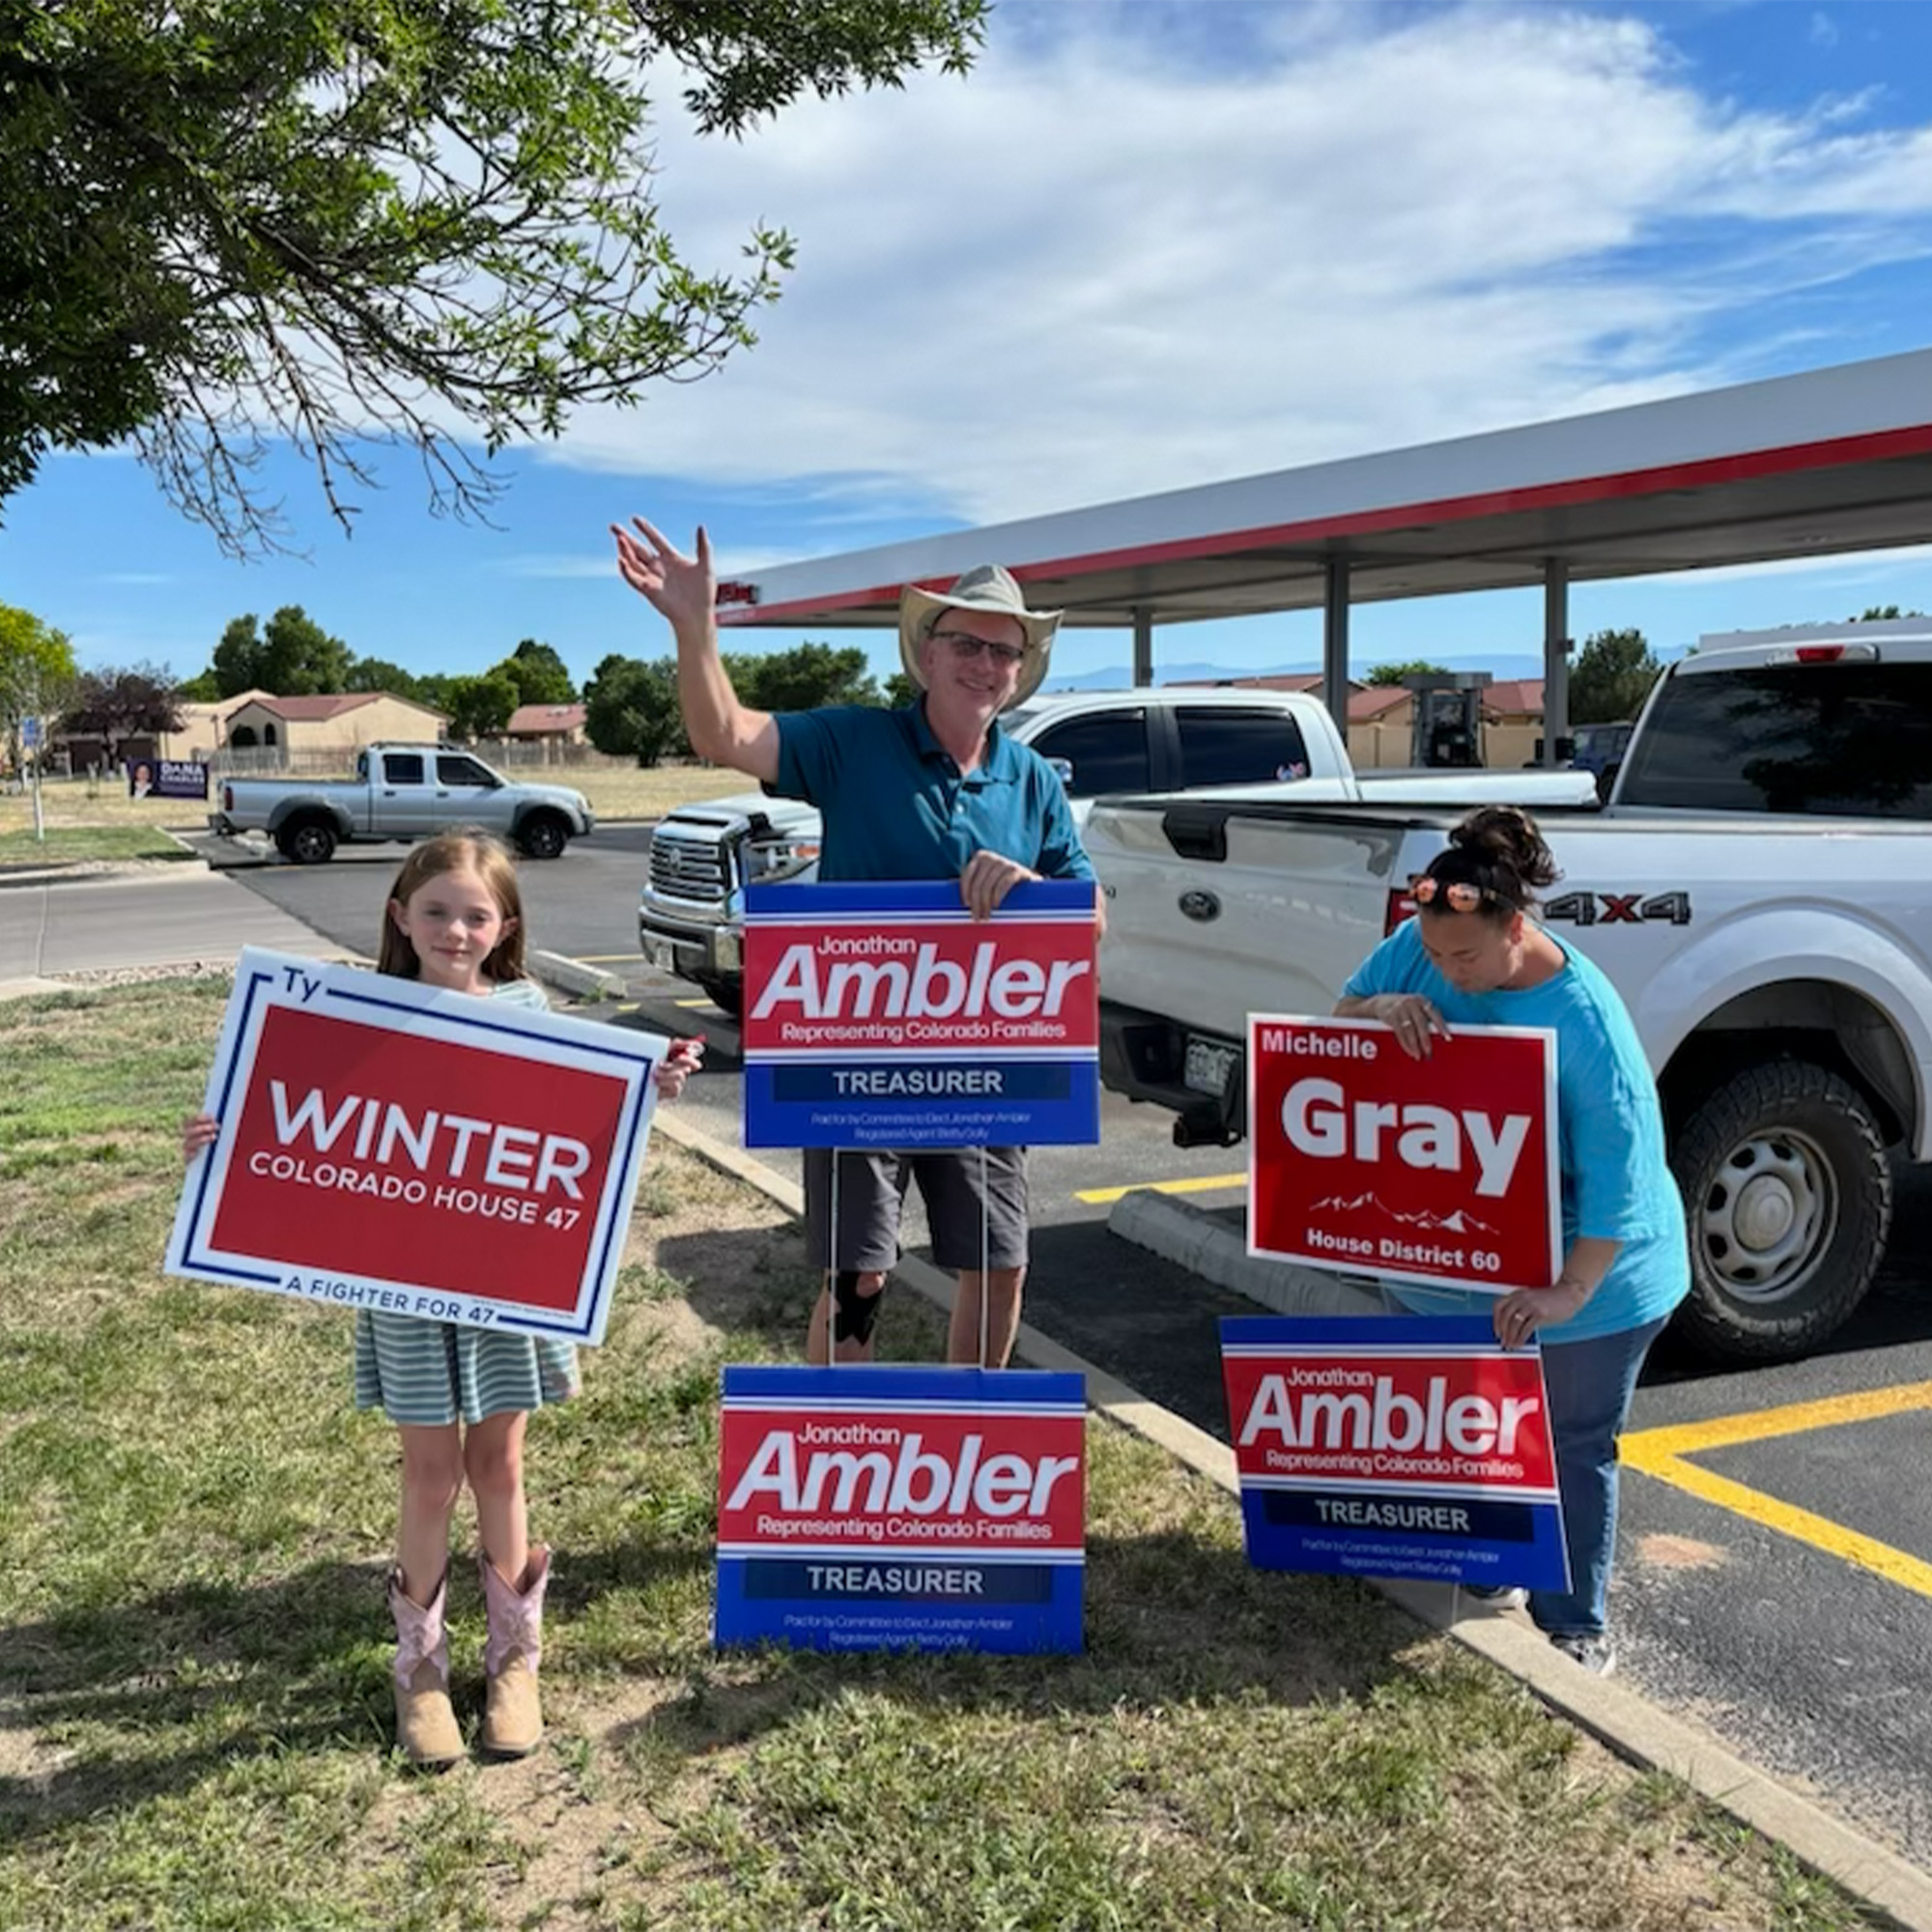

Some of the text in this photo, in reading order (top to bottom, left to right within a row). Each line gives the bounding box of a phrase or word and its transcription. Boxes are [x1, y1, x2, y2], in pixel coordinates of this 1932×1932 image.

[817, 934, 917, 955] Jonathan
[283, 965, 321, 1003] Ty
[751, 942, 1091, 1019] Ambler
[781, 1020, 1065, 1043] Representing Colorado Families
[1262, 1030, 1378, 1059] Michelle
[833, 1071, 1003, 1095] TREASURER
[269, 1080, 592, 1200] WINTER
[1281, 1077, 1532, 1198] Gray
[248, 1151, 580, 1232] COLORADO HOUSE 47
[1307, 1228, 1373, 1255] House
[1378, 1238, 1464, 1269] District
[1470, 1250, 1501, 1273] 60
[286, 1276, 302, 1293] A
[309, 1279, 409, 1312] FIGHTER
[414, 1296, 460, 1320] FOR
[468, 1306, 495, 1324] 47
[1287, 1368, 1374, 1388] Jonathan
[1239, 1375, 1539, 1456] Ambler
[798, 1423, 899, 1445] Jonathan
[725, 1431, 1078, 1517] Ambler
[1266, 1450, 1524, 1479] Representing Colorado Families
[757, 1515, 1053, 1541] Representing Colorado Families
[1315, 1499, 1470, 1532] TREASURER
[807, 1566, 983, 1594] TREASURER
